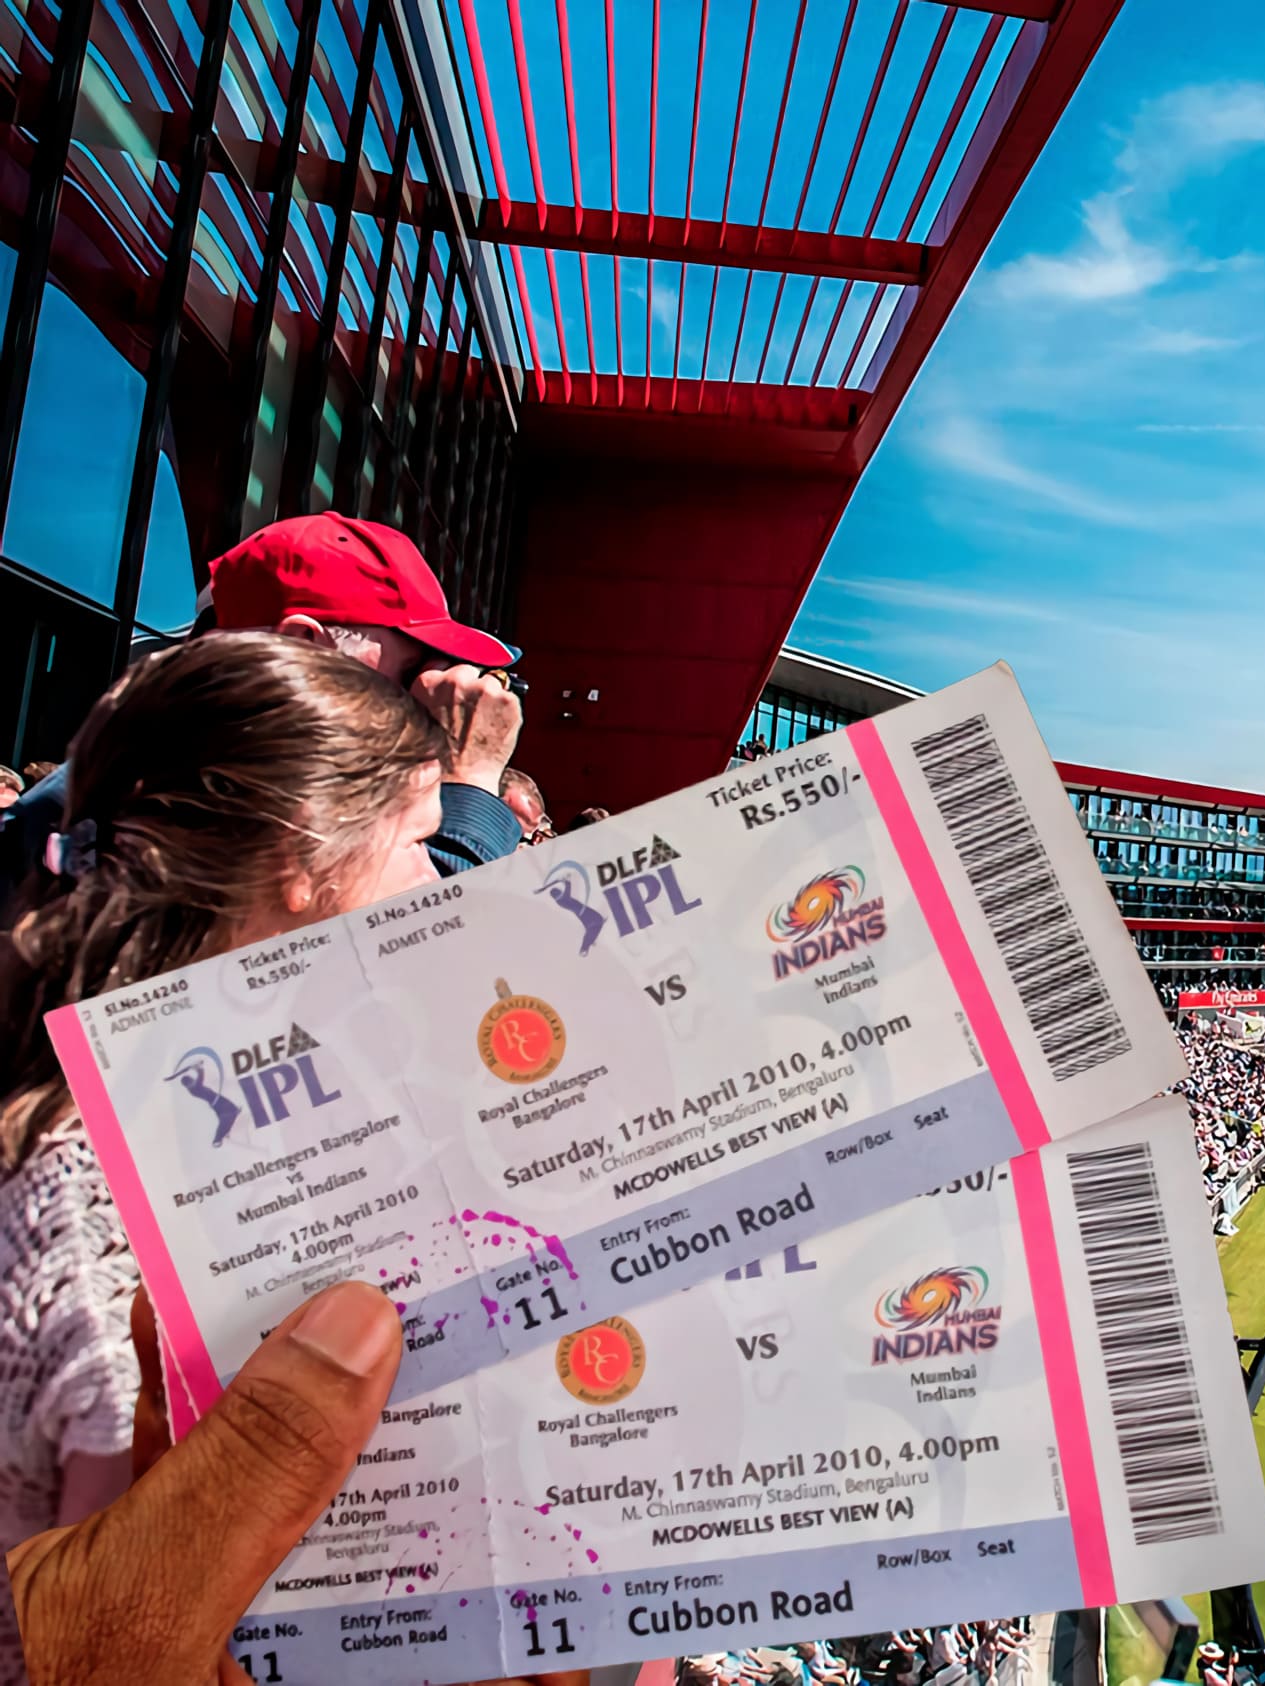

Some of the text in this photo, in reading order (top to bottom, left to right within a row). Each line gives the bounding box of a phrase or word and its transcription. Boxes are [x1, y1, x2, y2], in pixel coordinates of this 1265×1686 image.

[705, 752, 833, 808] Ticket Price:
[739, 766, 862, 831] Rs.550/-
[596, 847, 651, 887] DLF
[602, 863, 703, 938] IPL
[238, 933, 332, 972] Ticket Price:
[378, 915, 465, 958] ADMIT ONE
[772, 914, 887, 981] INDIANS
[247, 958, 311, 991] Rs.550/-
[815, 955, 875, 989] Mumbai
[823, 975, 879, 1004] Indians
[110, 996, 194, 1035] ADMIT ONE
[231, 1034, 287, 1076] DLF
[238, 1054, 342, 1131] IPL
[478, 1096, 520, 1123] Royal
[522, 1065, 608, 1105] Challengers
[503, 1136, 614, 1189] Saturday,
[618, 1106, 675, 1142] 17th
[683, 1078, 739, 1119] April
[743, 1052, 817, 1093] 2010,
[821, 1014, 912, 1060] 4.00pm
[512, 1092, 586, 1129] Bangalore
[601, 1123, 706, 1173] Chinnaswamy
[709, 1097, 777, 1131] Stadium,
[778, 1064, 855, 1102] Bengaluru
[825, 1105, 949, 1165] Row/Box Seat
[173, 1114, 400, 1208] Royal Challengers Bangalore
[613, 1093, 849, 1200] MCDOWELLS BEST VIEW (A)
[236, 1166, 368, 1225] Mumbai Indians
[208, 1185, 419, 1277] Saturday, 17th April 2010
[291, 1233, 354, 1265] 4.00pm
[600, 1208, 692, 1252] Entry From:
[610, 1223, 731, 1284] Cubbon
[735, 1181, 815, 1236] Road
[495, 1259, 564, 1291] Gate No.
[513, 1286, 569, 1331] 11
[944, 1305, 1002, 1326] MUMBAI
[406, 1328, 445, 1352] Road
[872, 1323, 1000, 1367] INDIANS
[910, 1364, 978, 1386] Mumbai
[916, 1385, 977, 1404] Indians
[380, 1402, 462, 1425] Bangalore
[538, 1405, 679, 1434] Royal Challengers
[356, 1448, 416, 1466] Indians
[570, 1428, 648, 1448] Bangalore
[545, 1434, 1000, 1507] Saturday, 17th April 2010, 4.00pm
[329, 1477, 460, 1508] 17th April 2010
[621, 1470, 929, 1522] M. Chinnaswamy Stadium, Bengaluru
[323, 1509, 387, 1528] 4.00pm
[652, 1496, 914, 1547] MCDOWELLS BEST VIEW (A)
[325, 1543, 390, 1561] Bengaluru
[877, 1539, 1016, 1570] Row/Box Seat
[275, 1573, 352, 1593] MCDOWELLS
[355, 1569, 382, 1584] BEST
[509, 1588, 582, 1609] Gate No.
[624, 1573, 724, 1598] Entry From:
[341, 1609, 432, 1632] Entry From:
[628, 1580, 854, 1636] Cubbon Road
[232, 1623, 303, 1643] Gate No.
[341, 1625, 447, 1652] Cubbon Road
[523, 1617, 576, 1656] 11
[237, 1651, 283, 1684] 11
